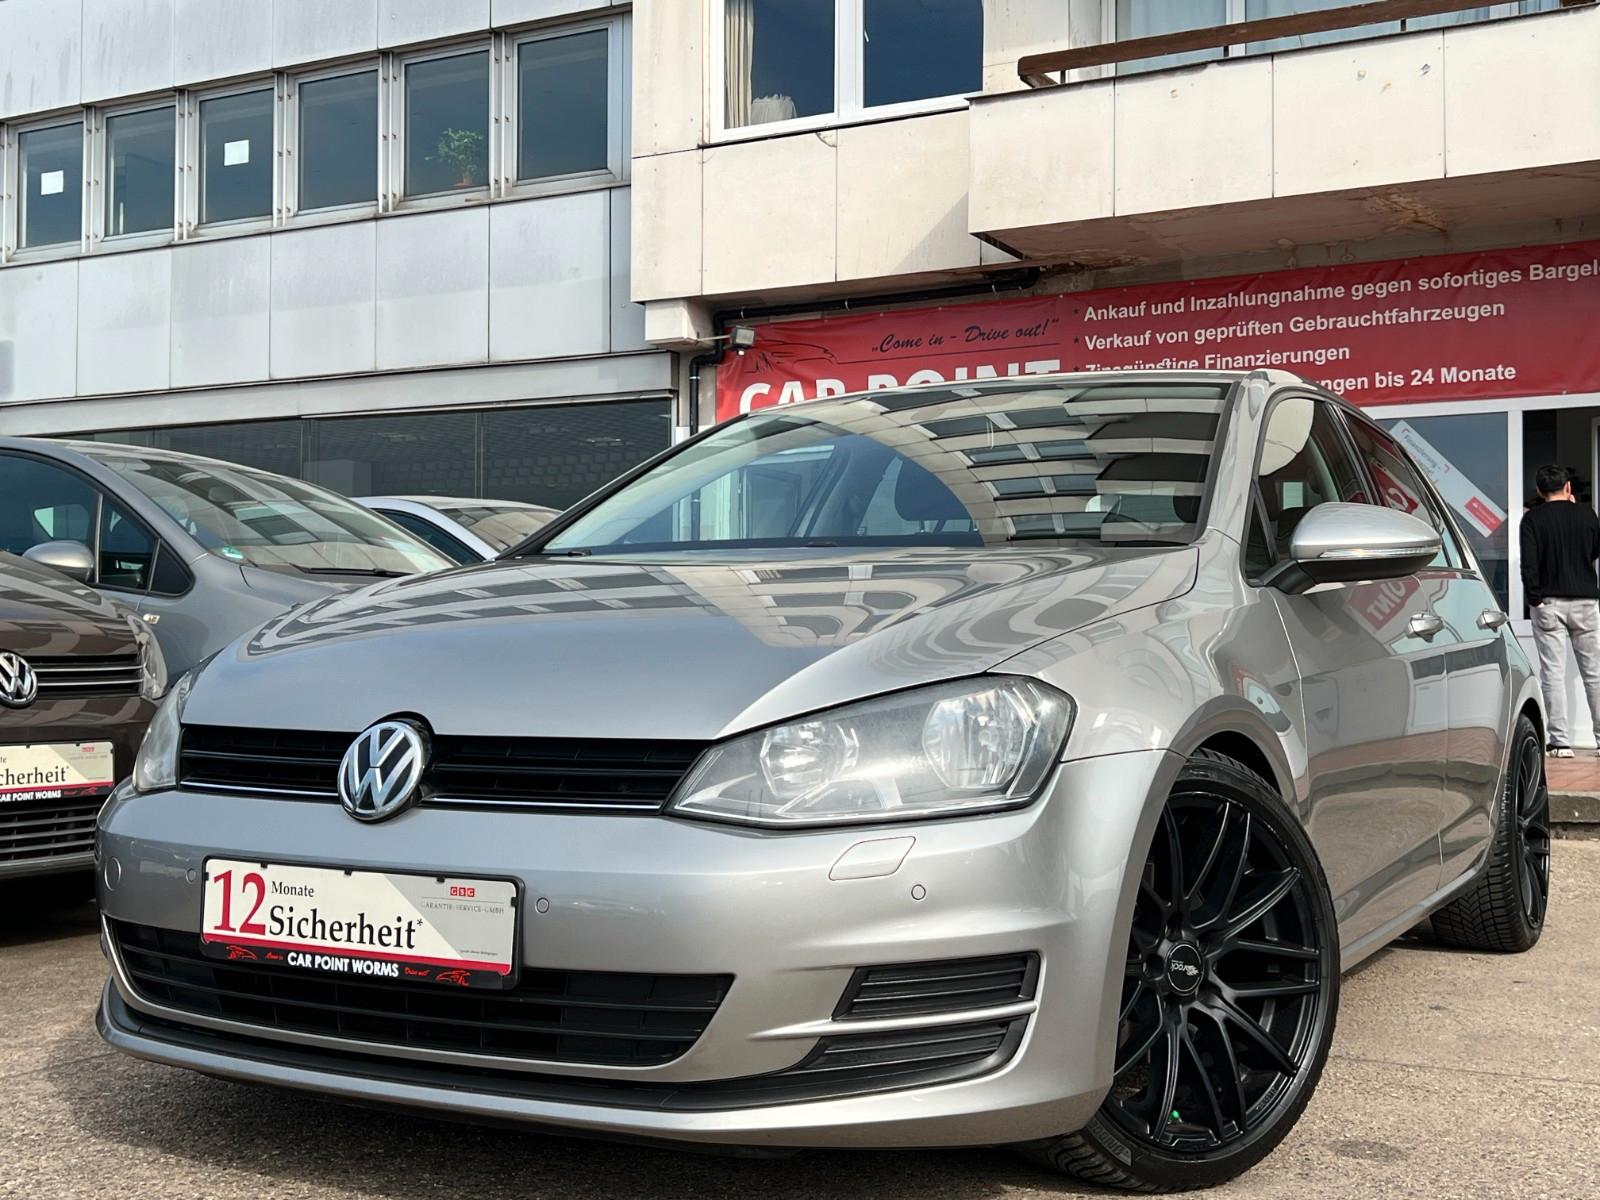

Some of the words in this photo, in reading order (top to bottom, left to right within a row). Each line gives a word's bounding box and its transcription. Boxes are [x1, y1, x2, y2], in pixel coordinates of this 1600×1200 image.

[1084, 301, 1146, 322] Ankauf
[1151, 297, 1185, 315] und
[1190, 284, 1345, 309] Inzahlungnahme
[1351, 278, 1412, 300] gegen
[1418, 268, 1522, 290] sofortiges
[1529, 259, 1600, 282] Bargel
[929, 334, 944, 346] in
[965, 325, 1009, 343] Drive
[1084, 330, 1151, 350] Verkauf
[1156, 331, 1189, 344] von
[1194, 320, 1283, 344] geprüften
[1289, 303, 1505, 333] Gebrauchtfahrzeugen
[1205, 346, 1350, 372] Finanzierungen
[1375, 371, 1404, 389] bis
[1411, 368, 1434, 386] 24
[1441, 364, 1516, 384] Monate
[214, 869, 266, 936] 12
[271, 881, 314, 898] Monate
[450, 886, 475, 897] GSG
[287, 952, 312, 968] CAR
[315, 955, 349, 972] POINT
[352, 959, 399, 978] WORMS
